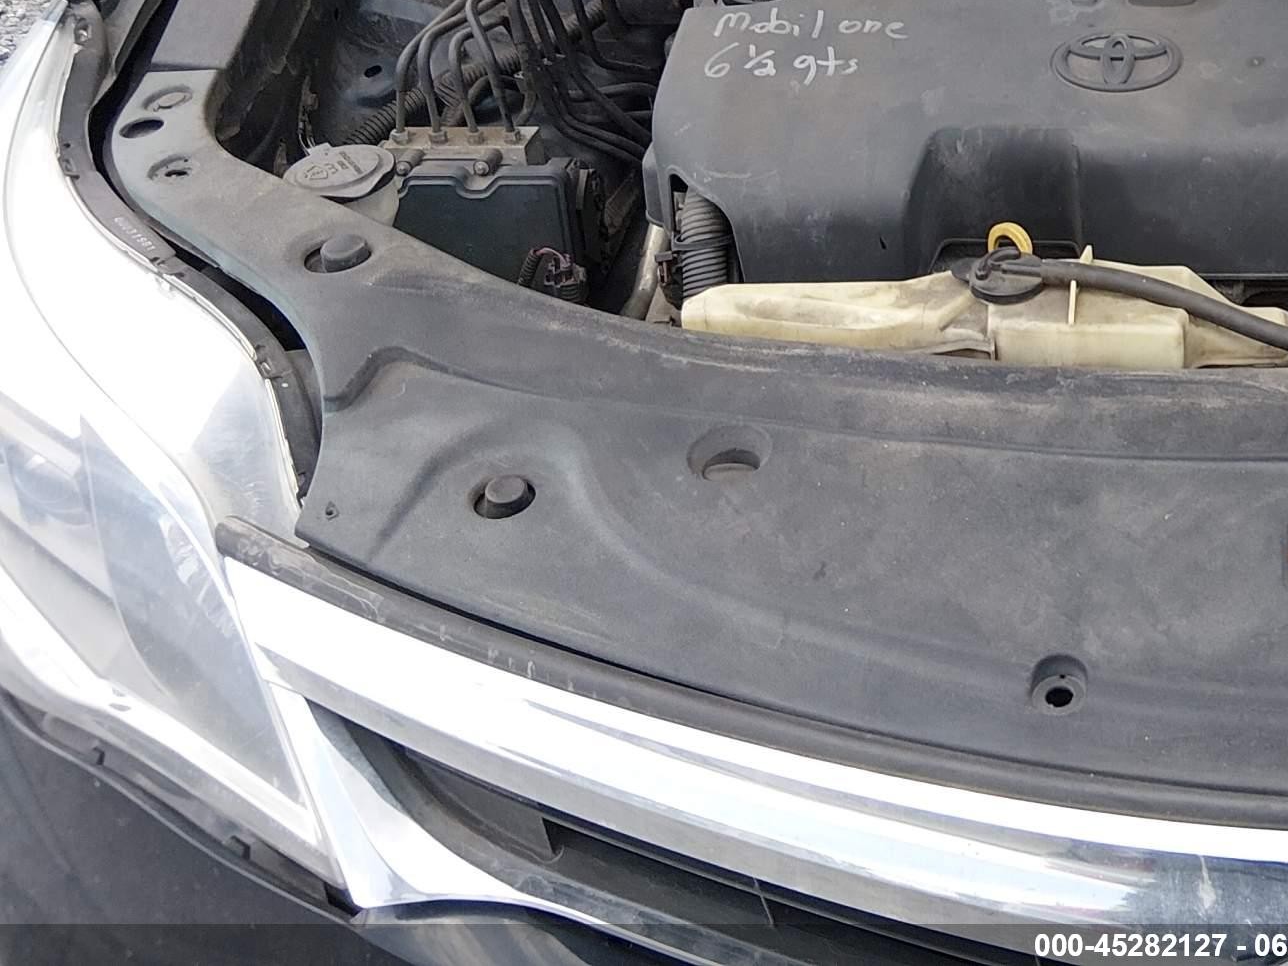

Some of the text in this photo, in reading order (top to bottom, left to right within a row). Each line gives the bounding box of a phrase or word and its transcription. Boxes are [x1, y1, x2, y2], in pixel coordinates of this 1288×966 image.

[713, 7, 908, 39] Mobil one
[704, 41, 739, 78] 6
